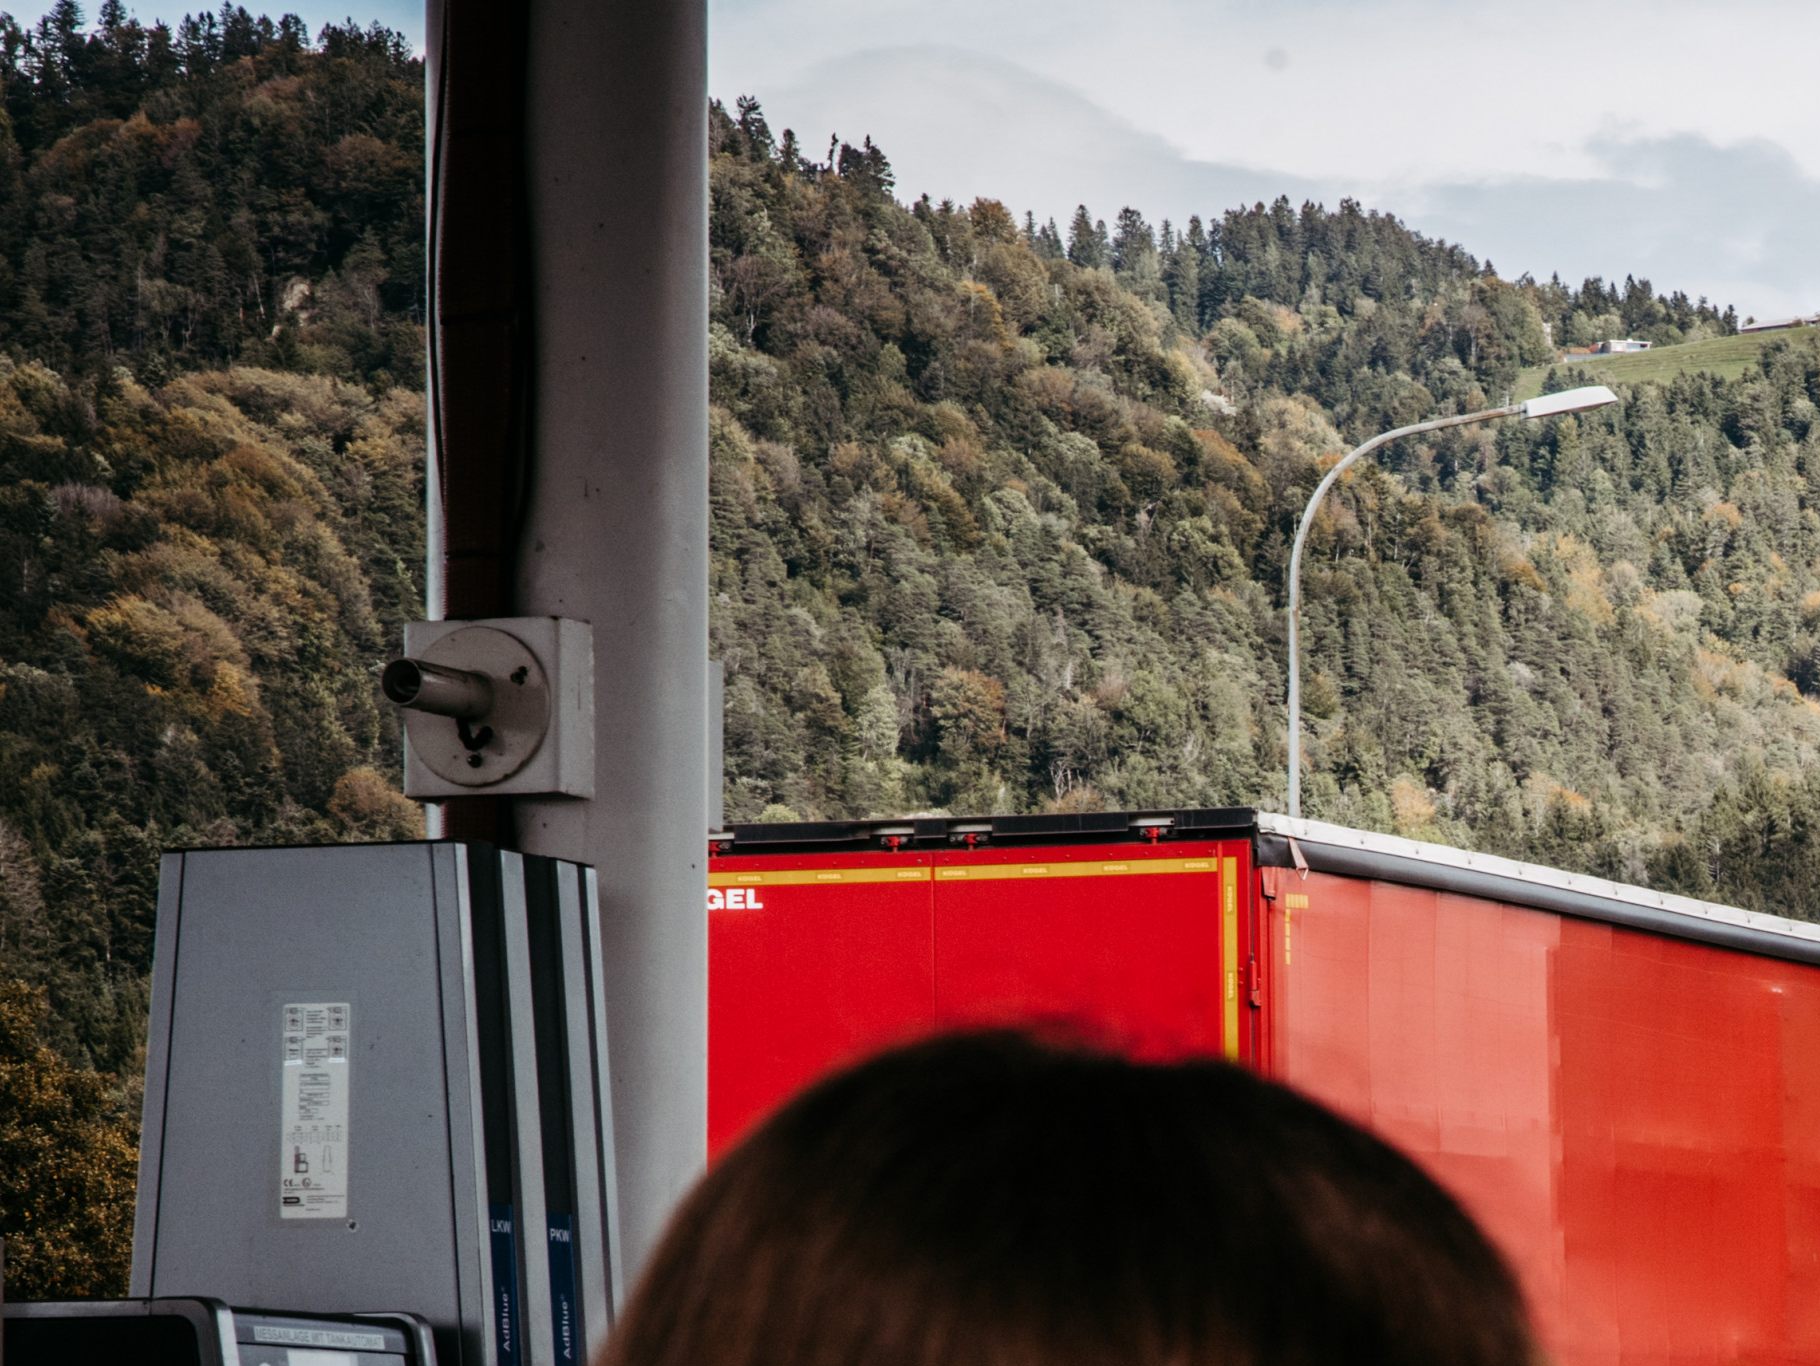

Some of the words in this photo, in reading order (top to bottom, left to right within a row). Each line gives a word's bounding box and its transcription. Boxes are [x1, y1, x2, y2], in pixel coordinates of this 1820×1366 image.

[707, 888, 764, 910] GEL
[491, 1219, 512, 1234] LKW
[550, 1228, 570, 1242] PKW
